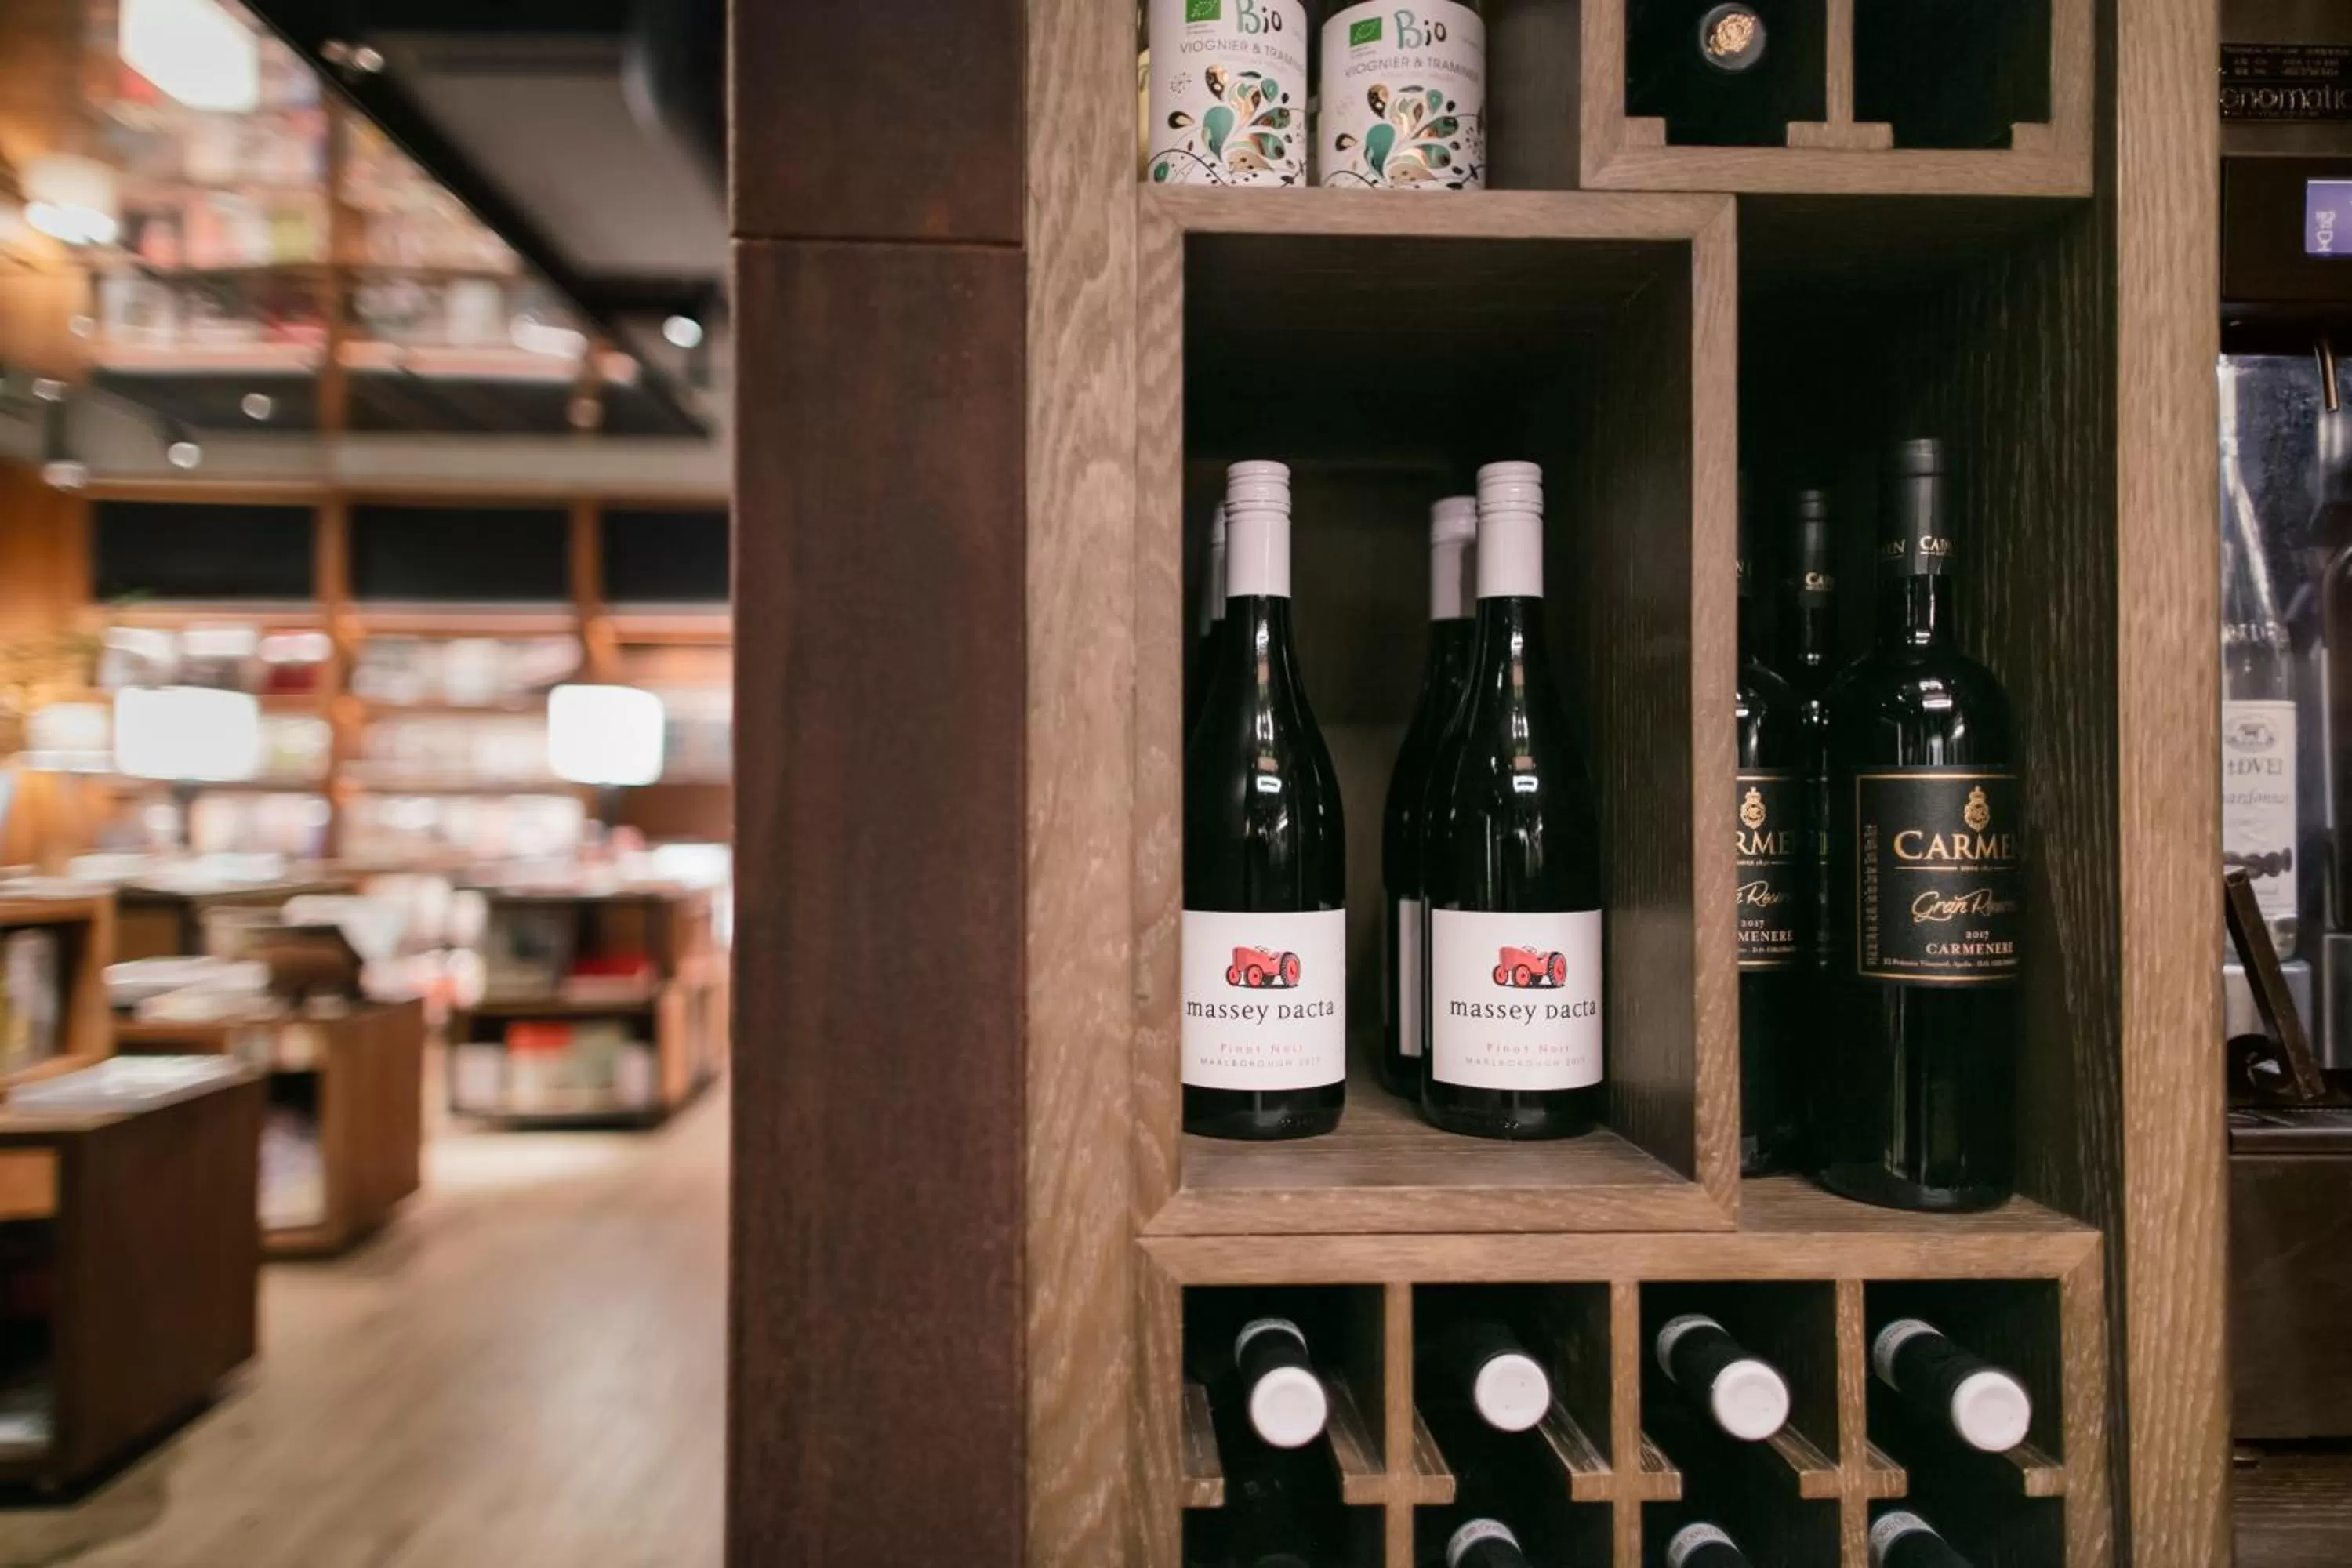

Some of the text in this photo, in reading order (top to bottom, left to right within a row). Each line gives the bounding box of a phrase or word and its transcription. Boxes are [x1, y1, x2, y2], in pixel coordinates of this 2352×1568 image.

[1235, 0, 1282, 34] Bio
[1394, 9, 1446, 49] Bio
[1893, 830, 2016, 860] CARME
[1738, 930, 1795, 942] MENERE
[1187, 1000, 1269, 1026] massey
[1450, 1000, 1537, 1026] massey
